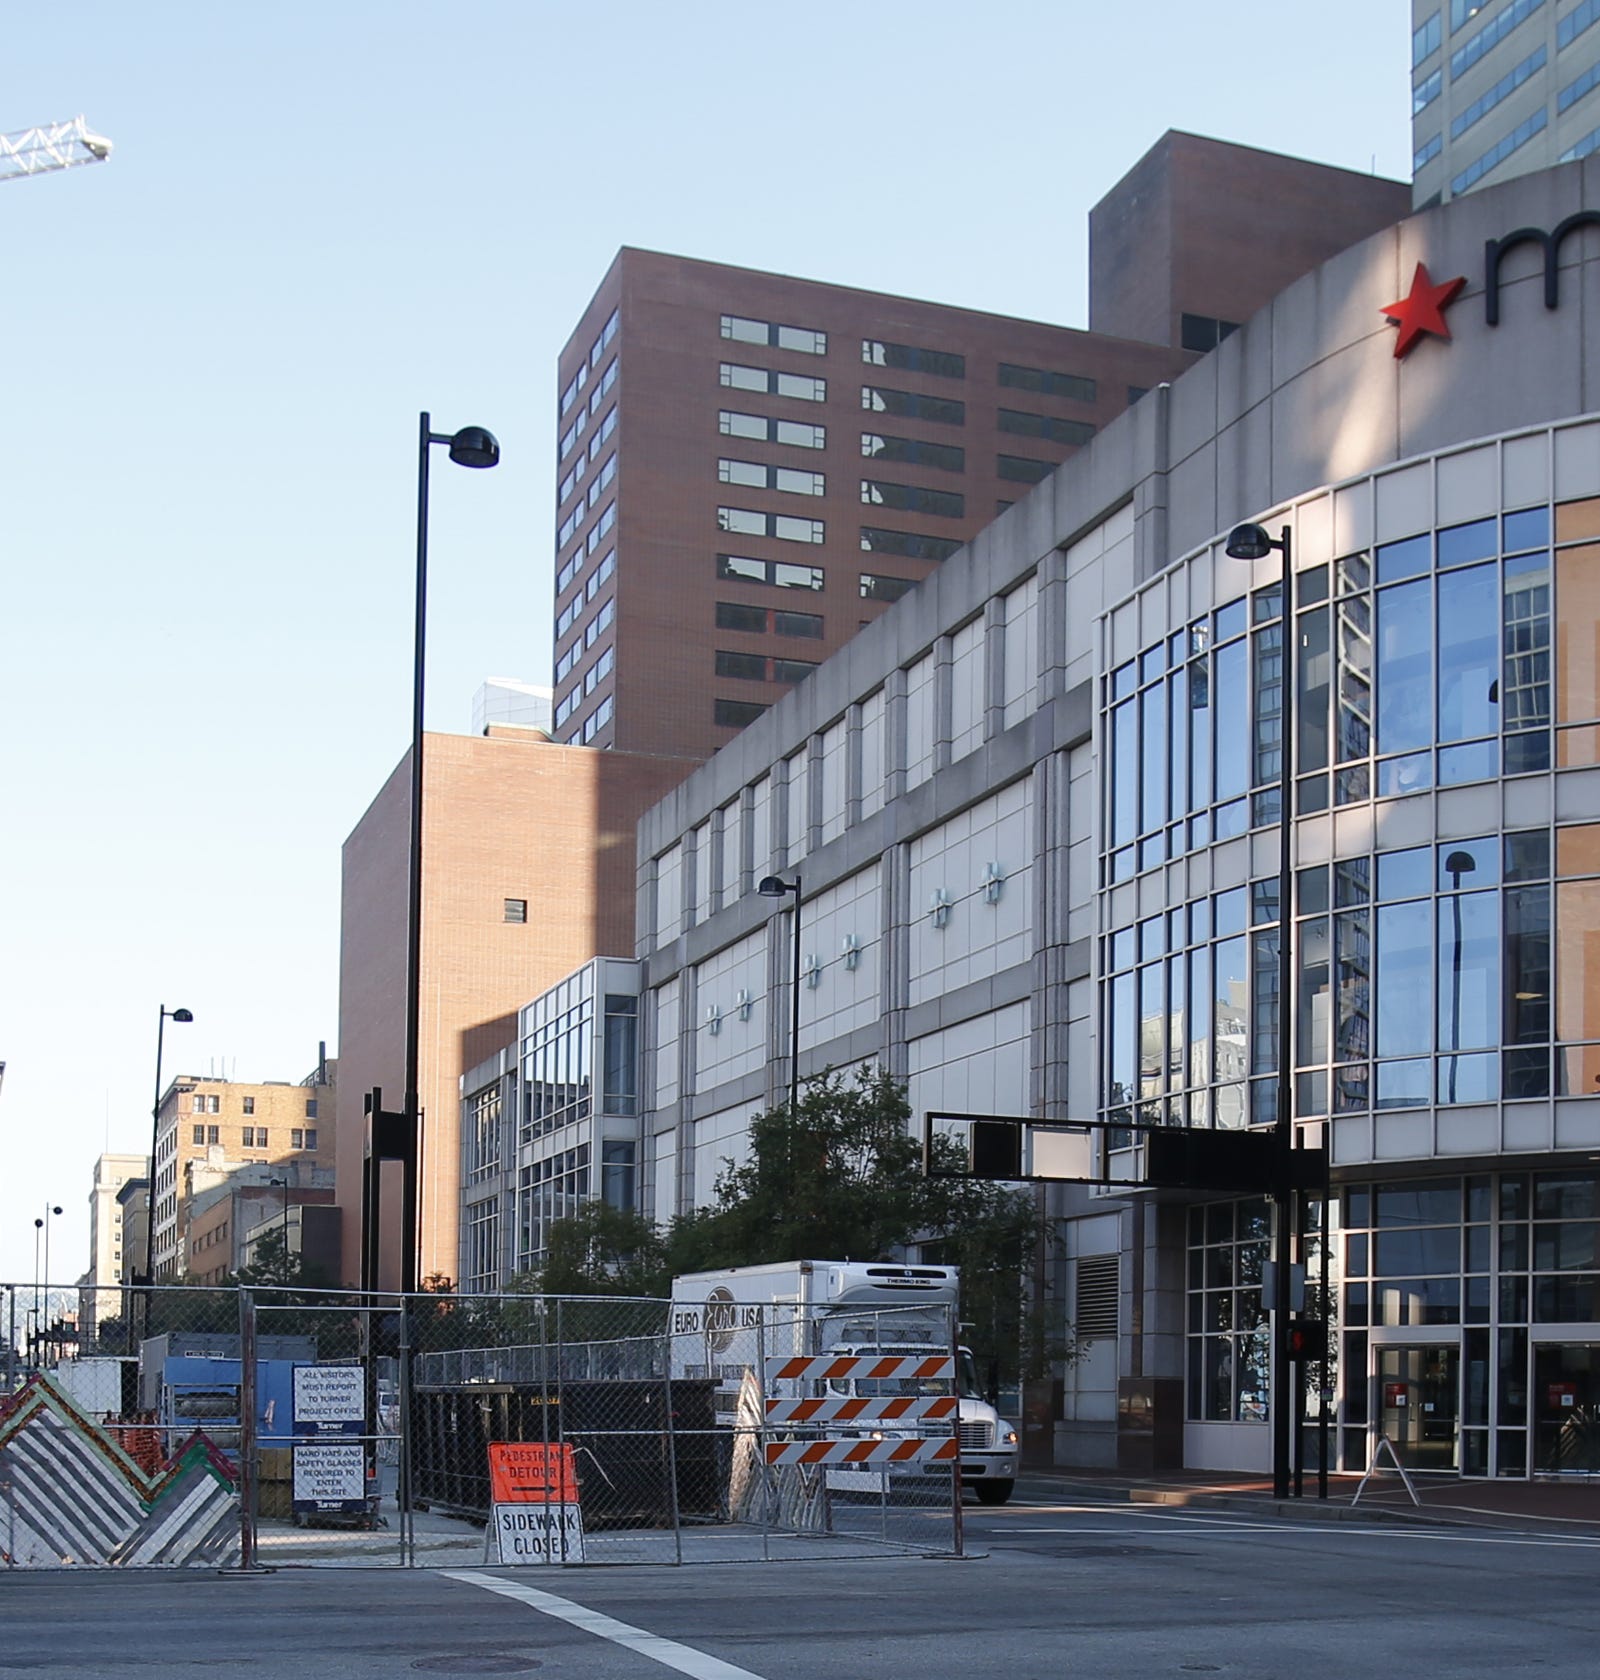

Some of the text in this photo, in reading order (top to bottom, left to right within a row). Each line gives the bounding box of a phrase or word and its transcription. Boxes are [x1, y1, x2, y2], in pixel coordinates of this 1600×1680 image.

[675, 1311, 699, 1333] EURO
[320, 1371, 355, 1379] VISITORS
[302, 1383, 357, 1391] MUST REPORT
[299, 1407, 361, 1416] PROJECT OFFICE
[316, 1422, 344, 1430] Turner
[297, 1450, 321, 1458] HARD
[344, 1449, 361, 1457] AND
[304, 1470, 343, 1478] REQUIRED
[311, 1488, 329, 1496] THIS
[316, 1501, 343, 1509] Turner
